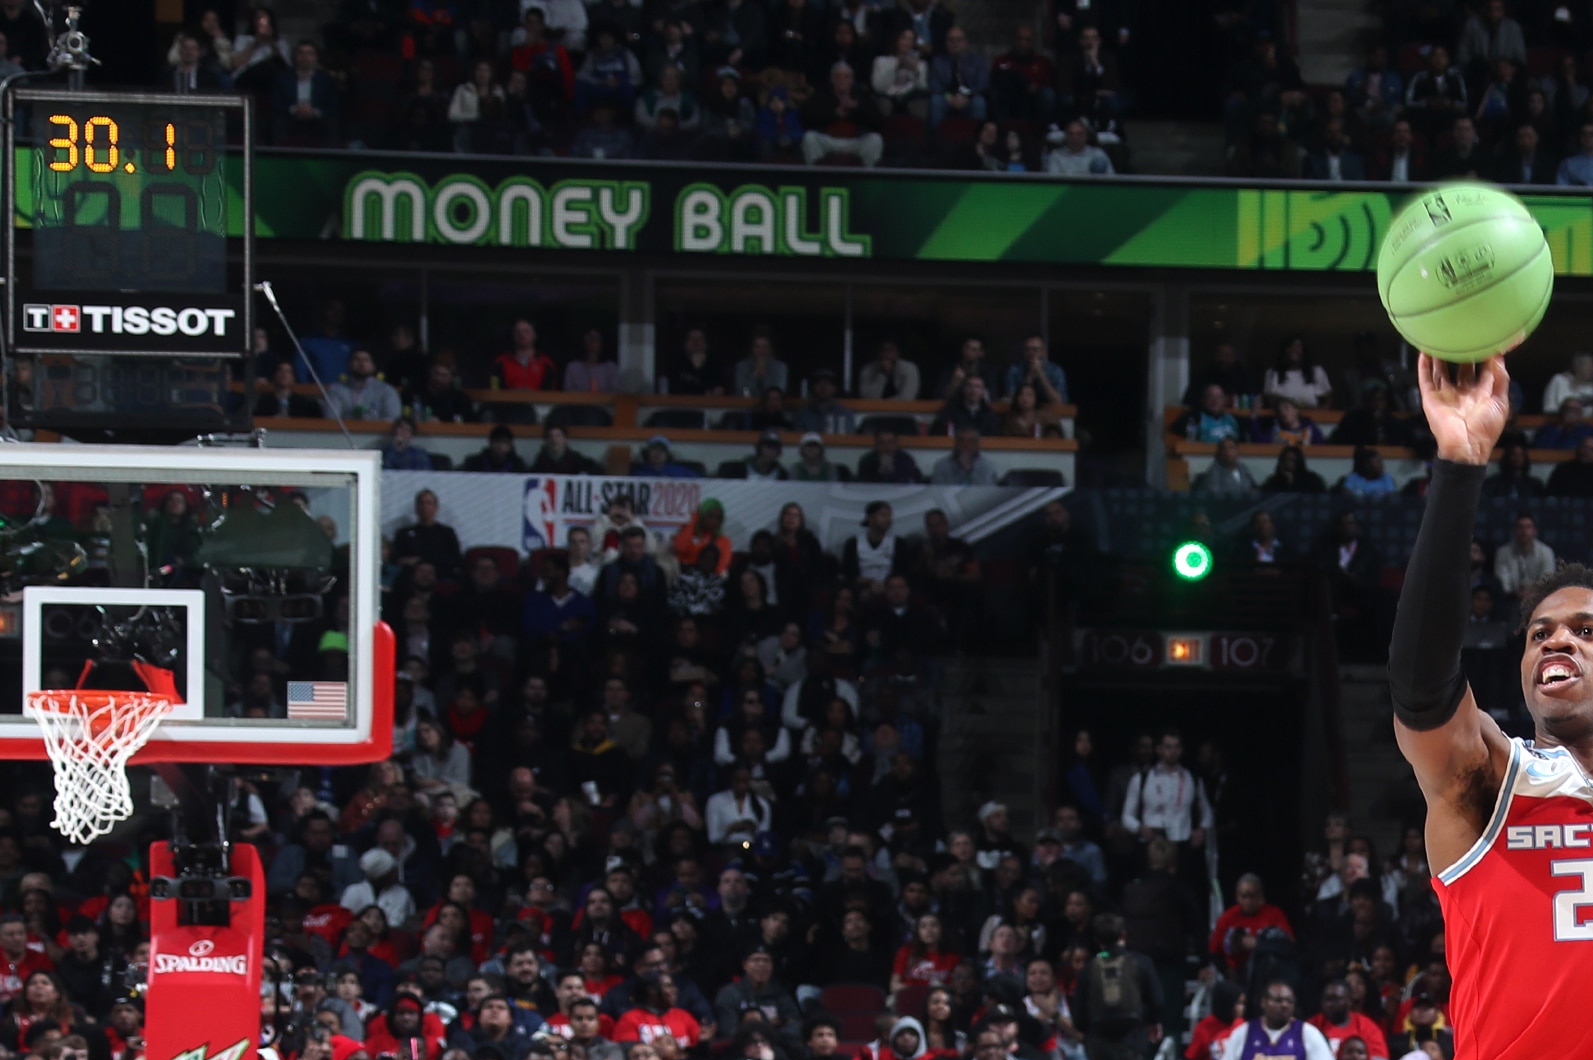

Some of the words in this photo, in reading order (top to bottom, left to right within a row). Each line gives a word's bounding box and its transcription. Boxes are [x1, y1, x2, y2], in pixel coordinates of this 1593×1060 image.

[49, 115, 176, 174] 30.1
[347, 174, 648, 250] MONEY
[678, 186, 868, 257] BALL
[82, 305, 235, 336] TISSOT
[653, 482, 700, 517] 2020
[154, 953, 248, 975] SPALDING
